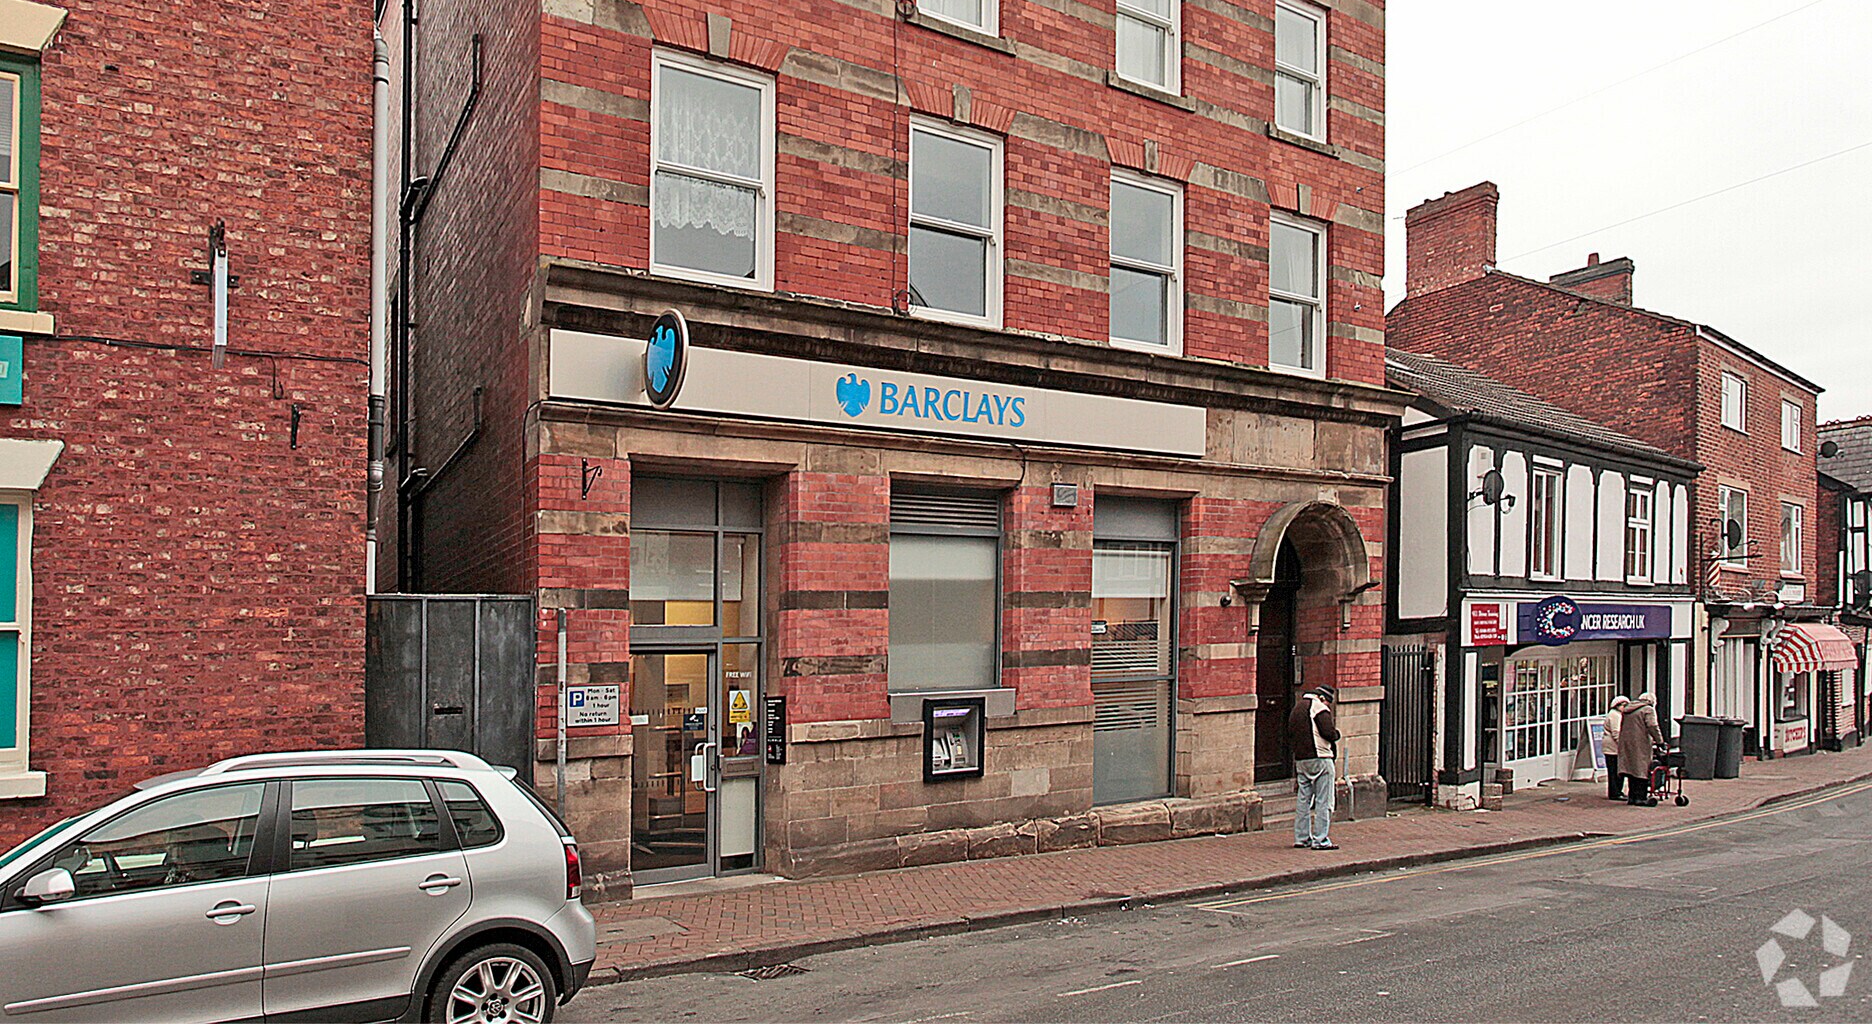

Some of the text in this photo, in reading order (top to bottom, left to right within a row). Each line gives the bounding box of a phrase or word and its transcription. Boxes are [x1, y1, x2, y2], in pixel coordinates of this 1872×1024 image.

[880, 382, 1026, 427] BARCLAYS
[1602, 614, 1635, 630] RESEARCH
[1636, 615, 1645, 629] UK
